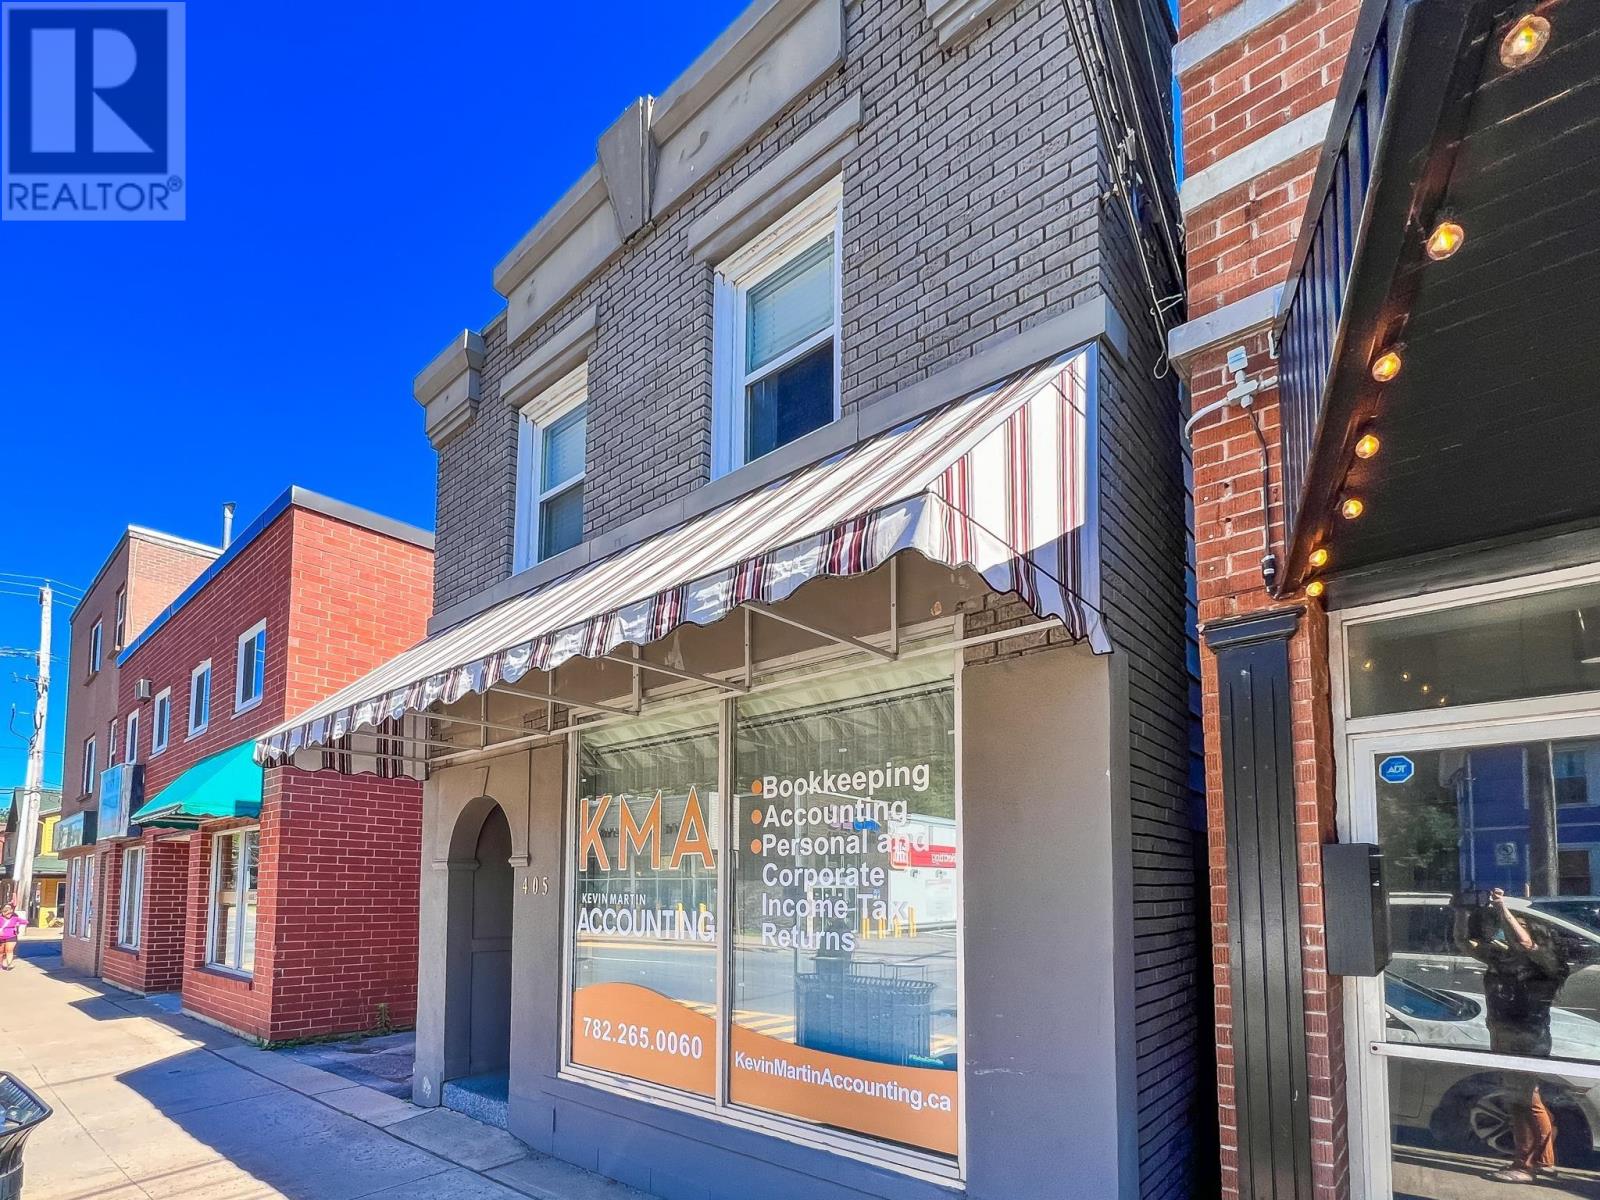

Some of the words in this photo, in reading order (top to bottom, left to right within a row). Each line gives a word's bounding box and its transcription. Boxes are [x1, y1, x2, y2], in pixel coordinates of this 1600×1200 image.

[762, 762, 930, 800] Bookkeeping
[1386, 764, 1407, 774] ADT
[763, 797, 908, 828] Accounting
[578, 785, 716, 872] KMA
[762, 828, 868, 857] Personal
[877, 825, 930, 855] and
[522, 876, 549, 896] 405
[762, 862, 885, 893] Corporate
[582, 892, 608, 904] KEVIN
[610, 893, 646, 905] MARTIN
[762, 892, 849, 919] Income
[857, 893, 909, 921] Tax
[577, 907, 716, 942] ACCOUNTING
[761, 922, 856, 952] Returns
[582, 1016, 704, 1060] 782.265.0060
[734, 1051, 952, 1113] KevinMartinAccounting.ca
